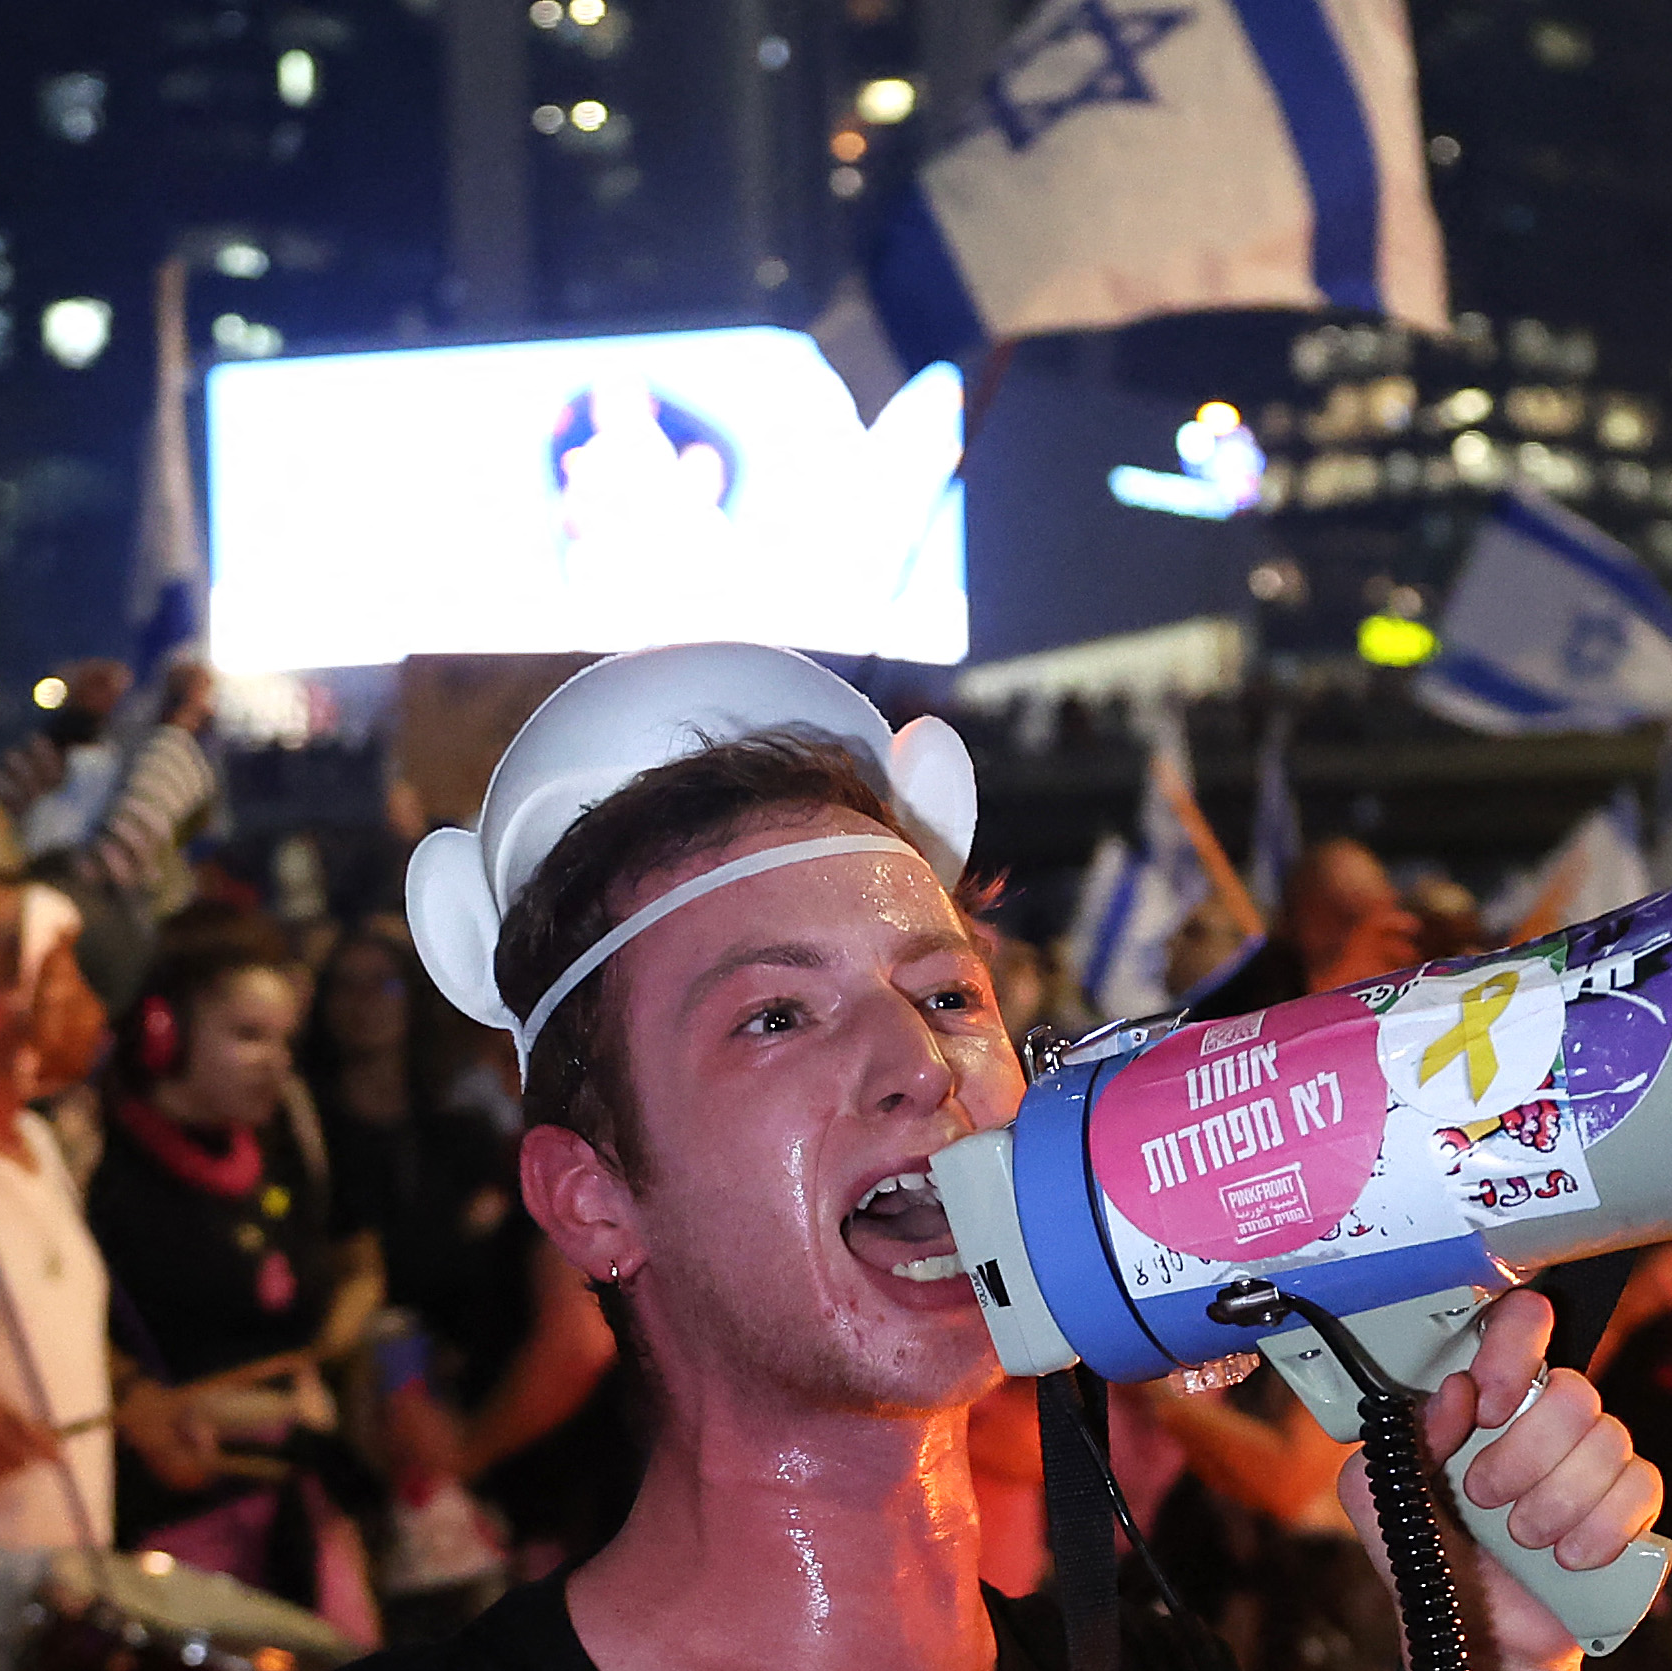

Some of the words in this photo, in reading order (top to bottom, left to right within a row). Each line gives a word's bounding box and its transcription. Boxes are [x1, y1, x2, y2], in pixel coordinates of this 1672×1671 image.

[1186, 1040, 1279, 1110] אנחנו
[1289, 1071, 1344, 1136] לא
[1140, 1097, 1284, 1194] מפחדות
[1228, 1175, 1295, 1209] PINKFRONT
